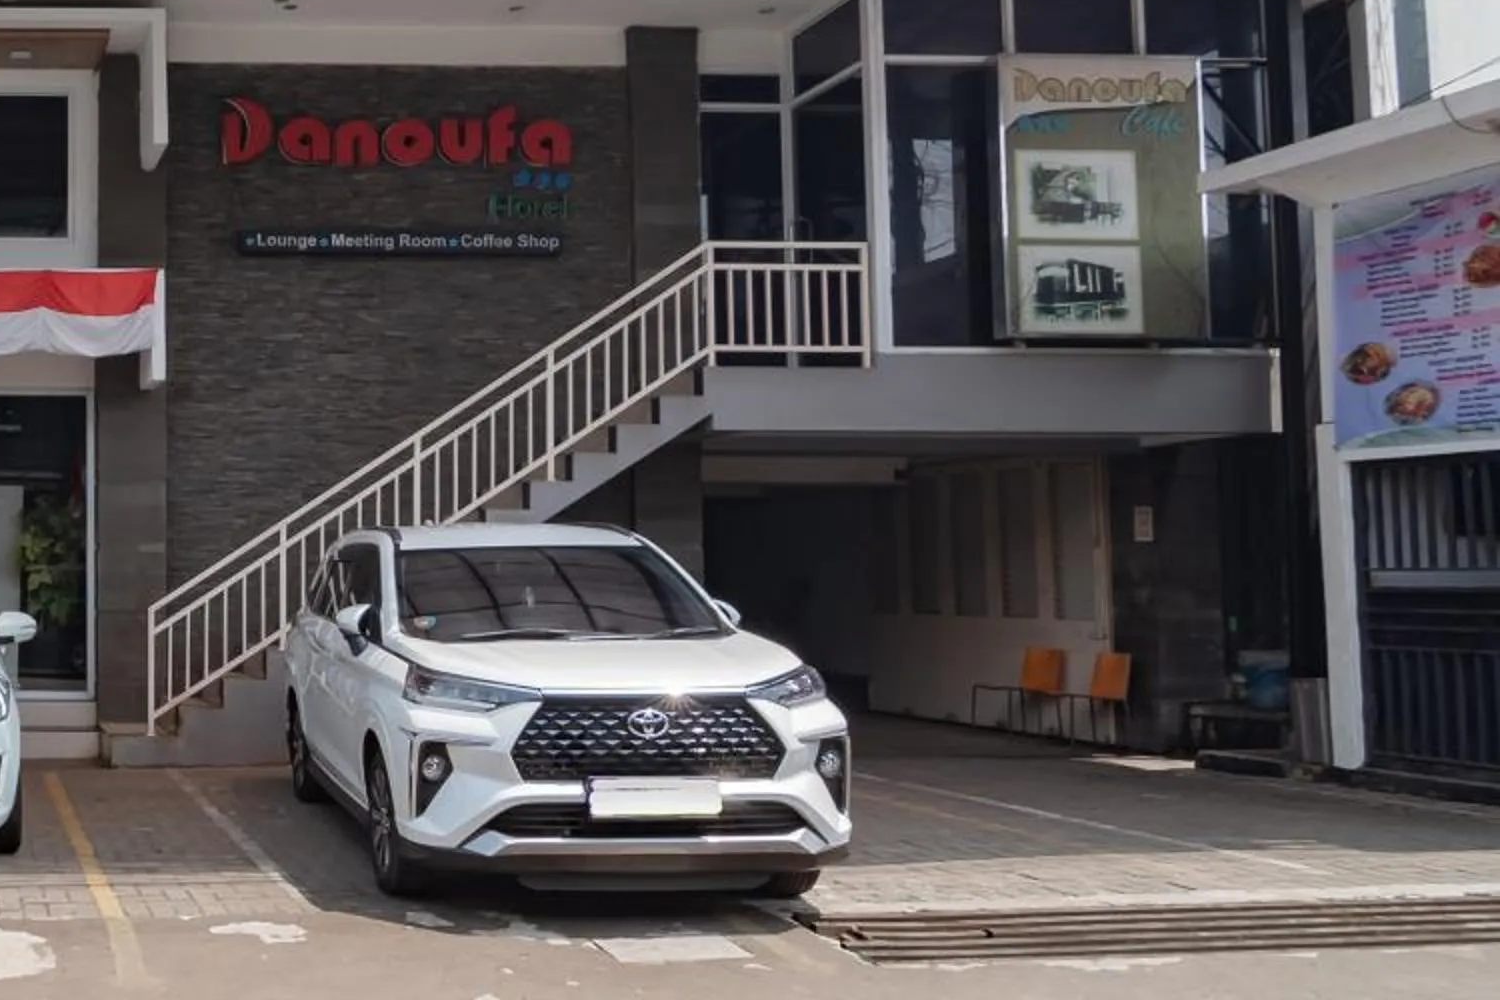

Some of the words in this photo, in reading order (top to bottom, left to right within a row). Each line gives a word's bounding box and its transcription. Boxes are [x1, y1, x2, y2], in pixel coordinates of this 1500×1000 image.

[1013, 67, 1187, 103] Danoufa
[221, 96, 573, 168] Danoufa
[487, 193, 568, 220] Hotel
[256, 232, 317, 251] Lounge
[331, 232, 395, 251] Meeting
[399, 232, 447, 248] Room
[461, 232, 513, 248] Coffee
[517, 232, 560, 251] Shop
